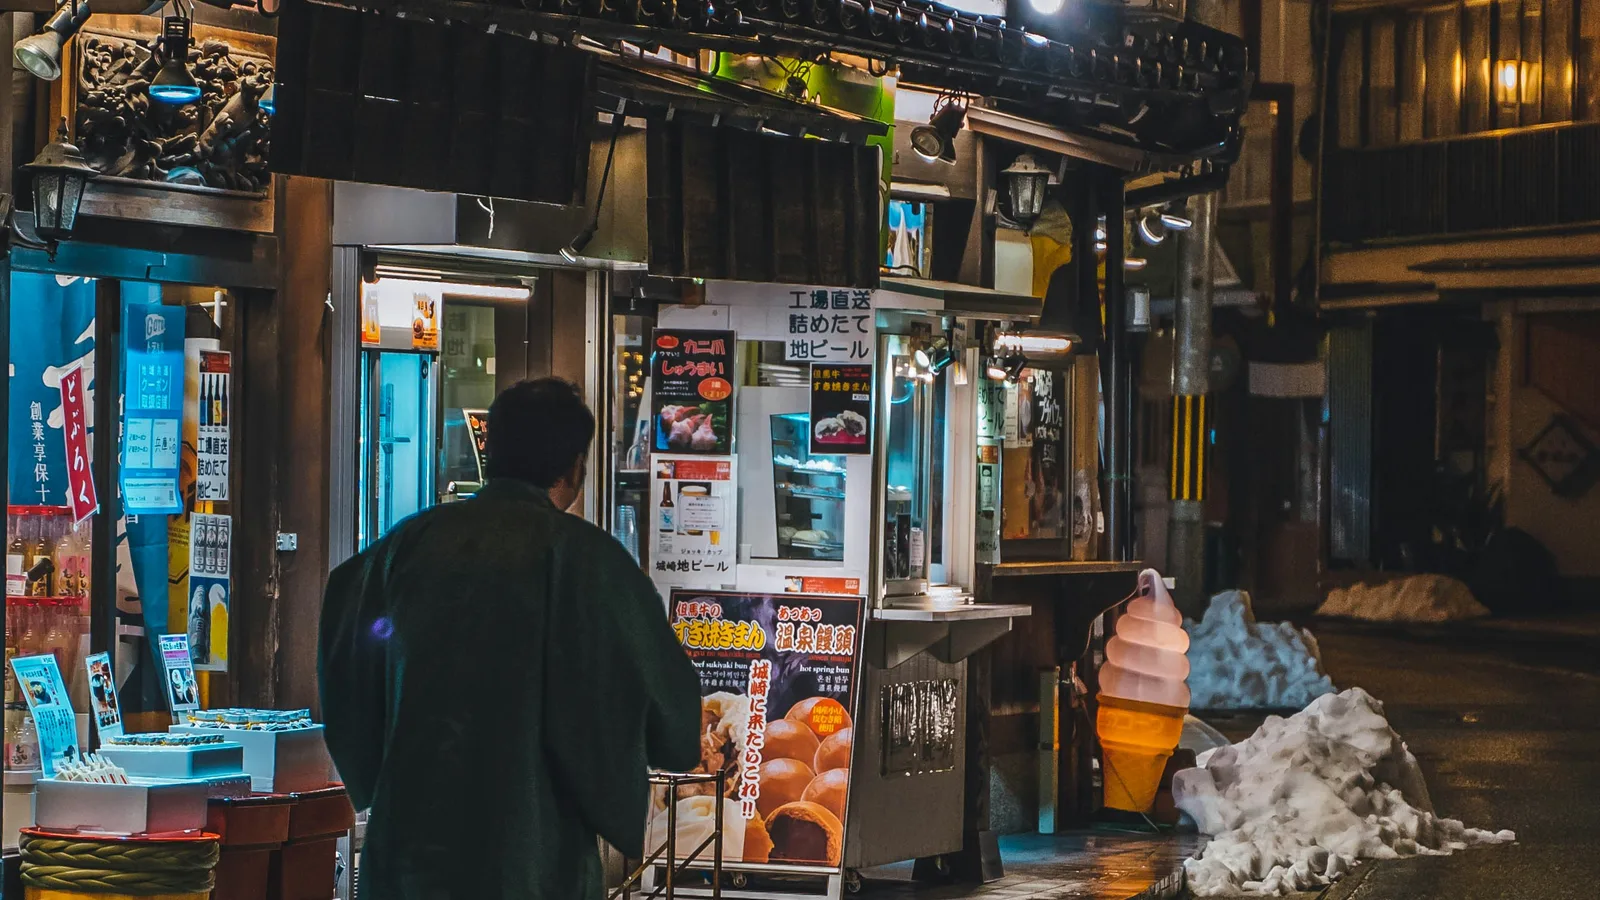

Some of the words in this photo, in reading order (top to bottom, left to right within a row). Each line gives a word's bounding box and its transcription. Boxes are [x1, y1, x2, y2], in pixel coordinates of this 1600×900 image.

[788, 289, 872, 309] 工場直送
[789, 313, 870, 334] 詰めたて
[683, 338, 726, 355] カニ爪
[789, 339, 870, 360] 地ビール
[662, 360, 724, 377] しゅうまい
[141, 379, 169, 392] クーポン
[813, 381, 870, 391] すき焼きまん
[66, 375, 91, 505] どぶろく
[198, 438, 228, 456] 工場直送
[29, 401, 51, 506] 創業享保十
[197, 458, 227, 477] 詰めたて
[197, 482, 227, 500] 地ビール
[655, 558, 729, 572] 城崎地ビール
[676, 601, 721, 617] 但馬牛の
[777, 605, 822, 622] あつあつ
[673, 620, 766, 649] すき焼きまん
[776, 623, 856, 655] 温泉饅頭
[706, 661, 733, 670] sukiyaki
[799, 664, 812, 672] hot
[813, 666, 835, 674] spring
[818, 724, 834, 732] 使用
[740, 660, 772, 818] 城崎に来たらこれ!!
